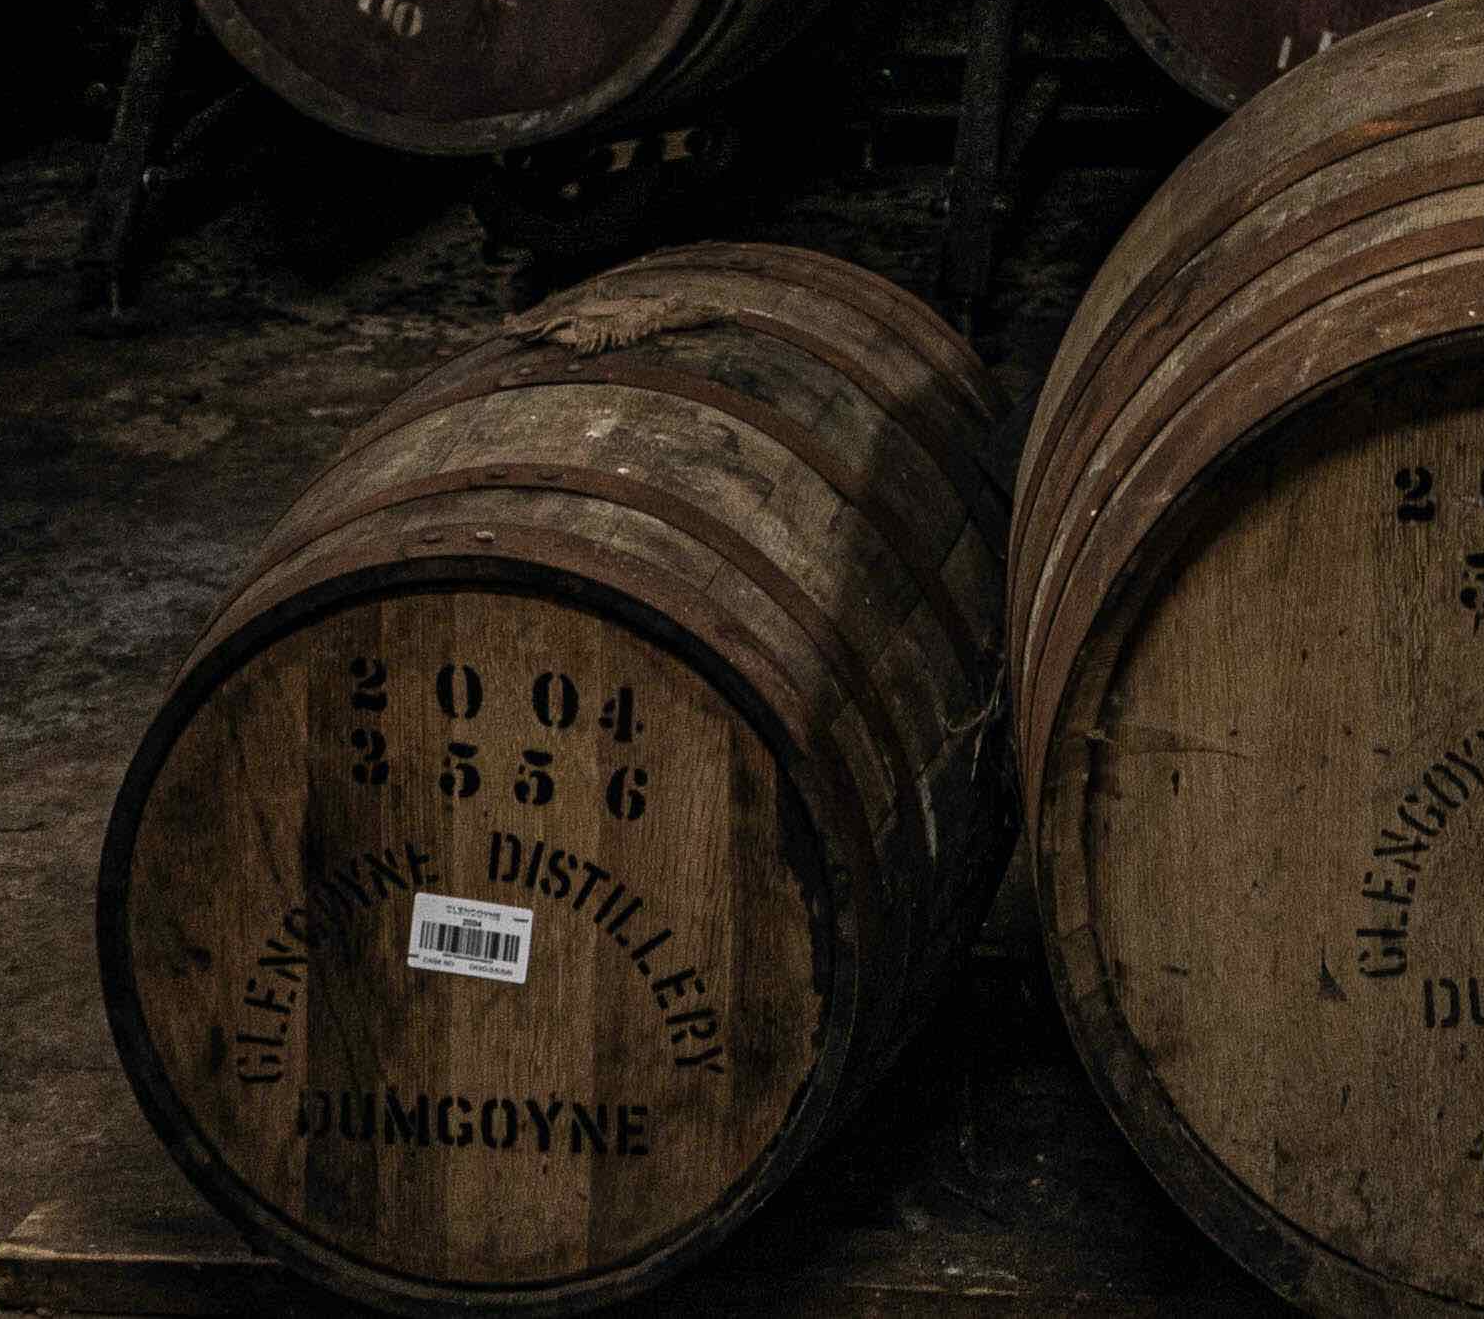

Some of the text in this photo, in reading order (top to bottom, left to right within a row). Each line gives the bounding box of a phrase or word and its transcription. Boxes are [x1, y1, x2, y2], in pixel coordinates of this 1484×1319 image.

[350, 659, 644, 745] 2004
[350, 726, 648, 822] 2556
[487, 829, 727, 1075] DISTILLERY
[296, 1087, 650, 1157] DUMGOYNE
